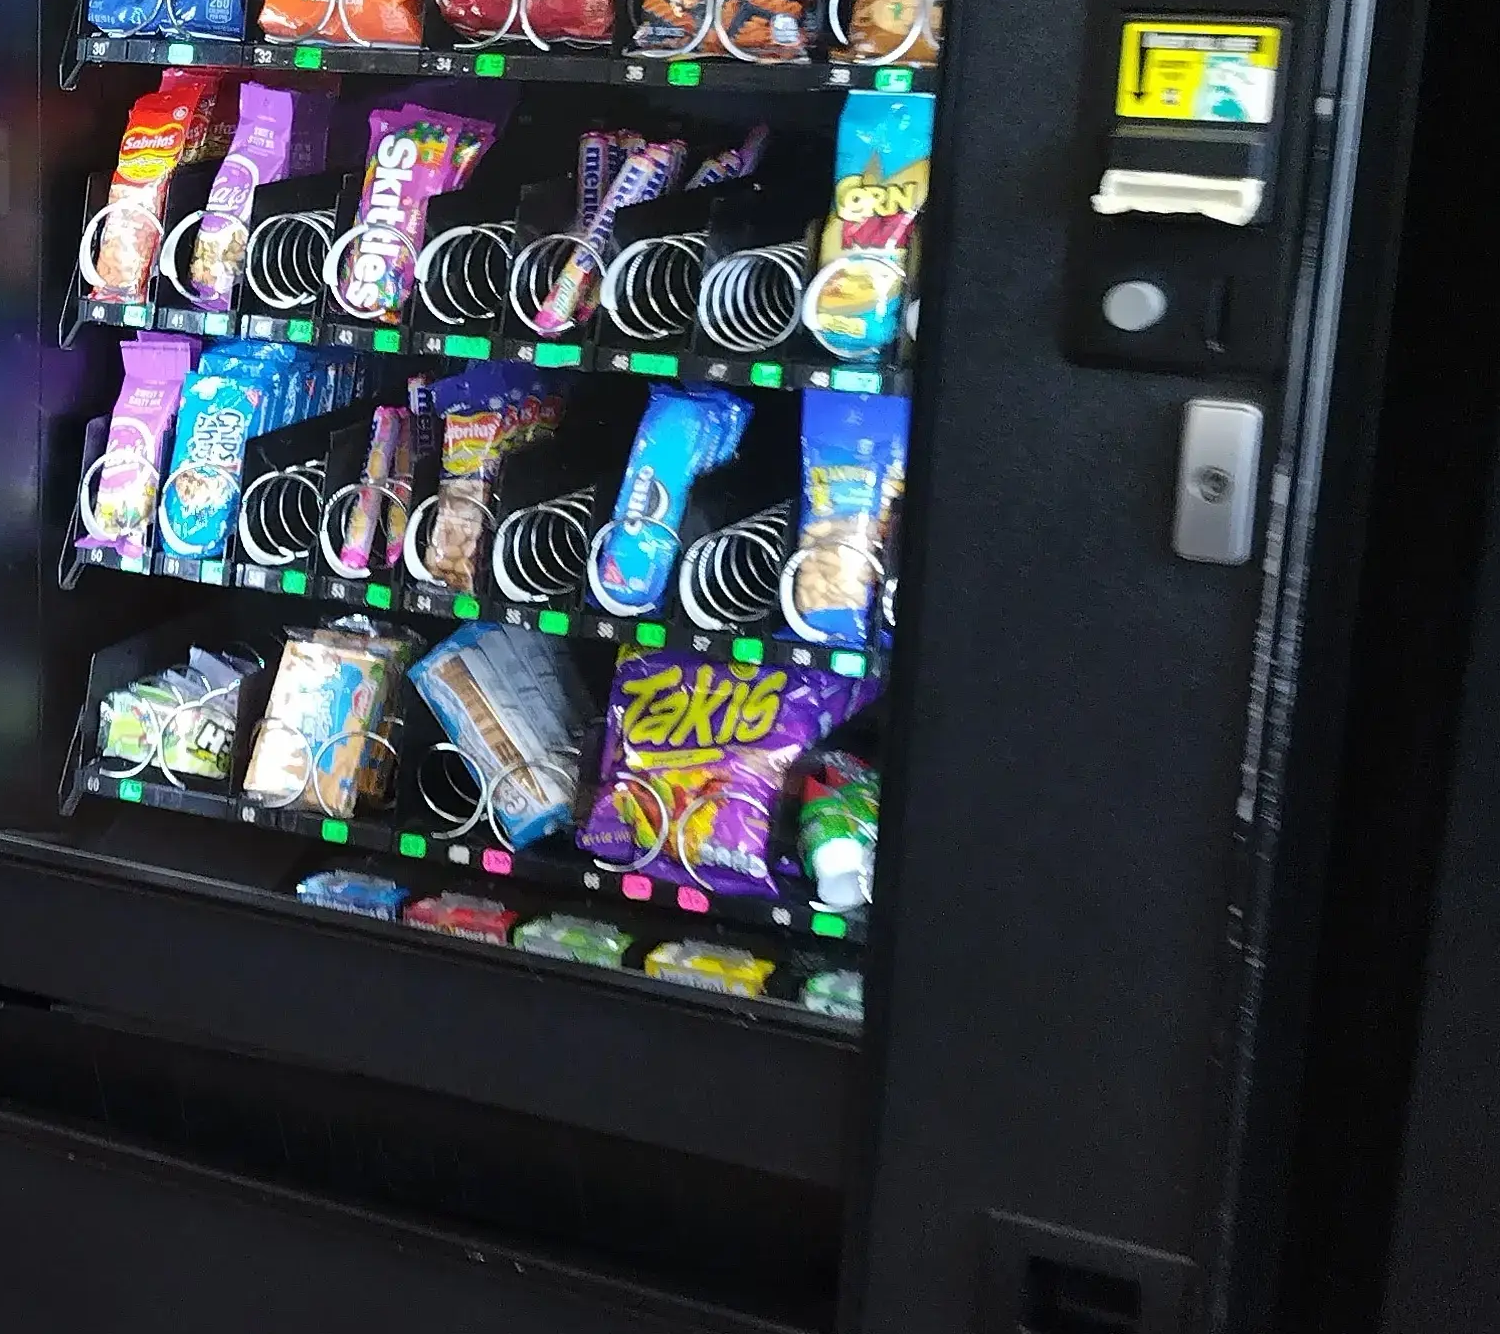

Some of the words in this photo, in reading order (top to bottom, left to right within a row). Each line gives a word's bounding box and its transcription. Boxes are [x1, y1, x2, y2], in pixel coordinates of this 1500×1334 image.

[92, 42, 107, 56] 30
[256, 49, 272, 64] 32
[123, 134, 176, 151] Sabritas
[346, 134, 418, 308] Skittles
[216, 411, 242, 464] Chips
